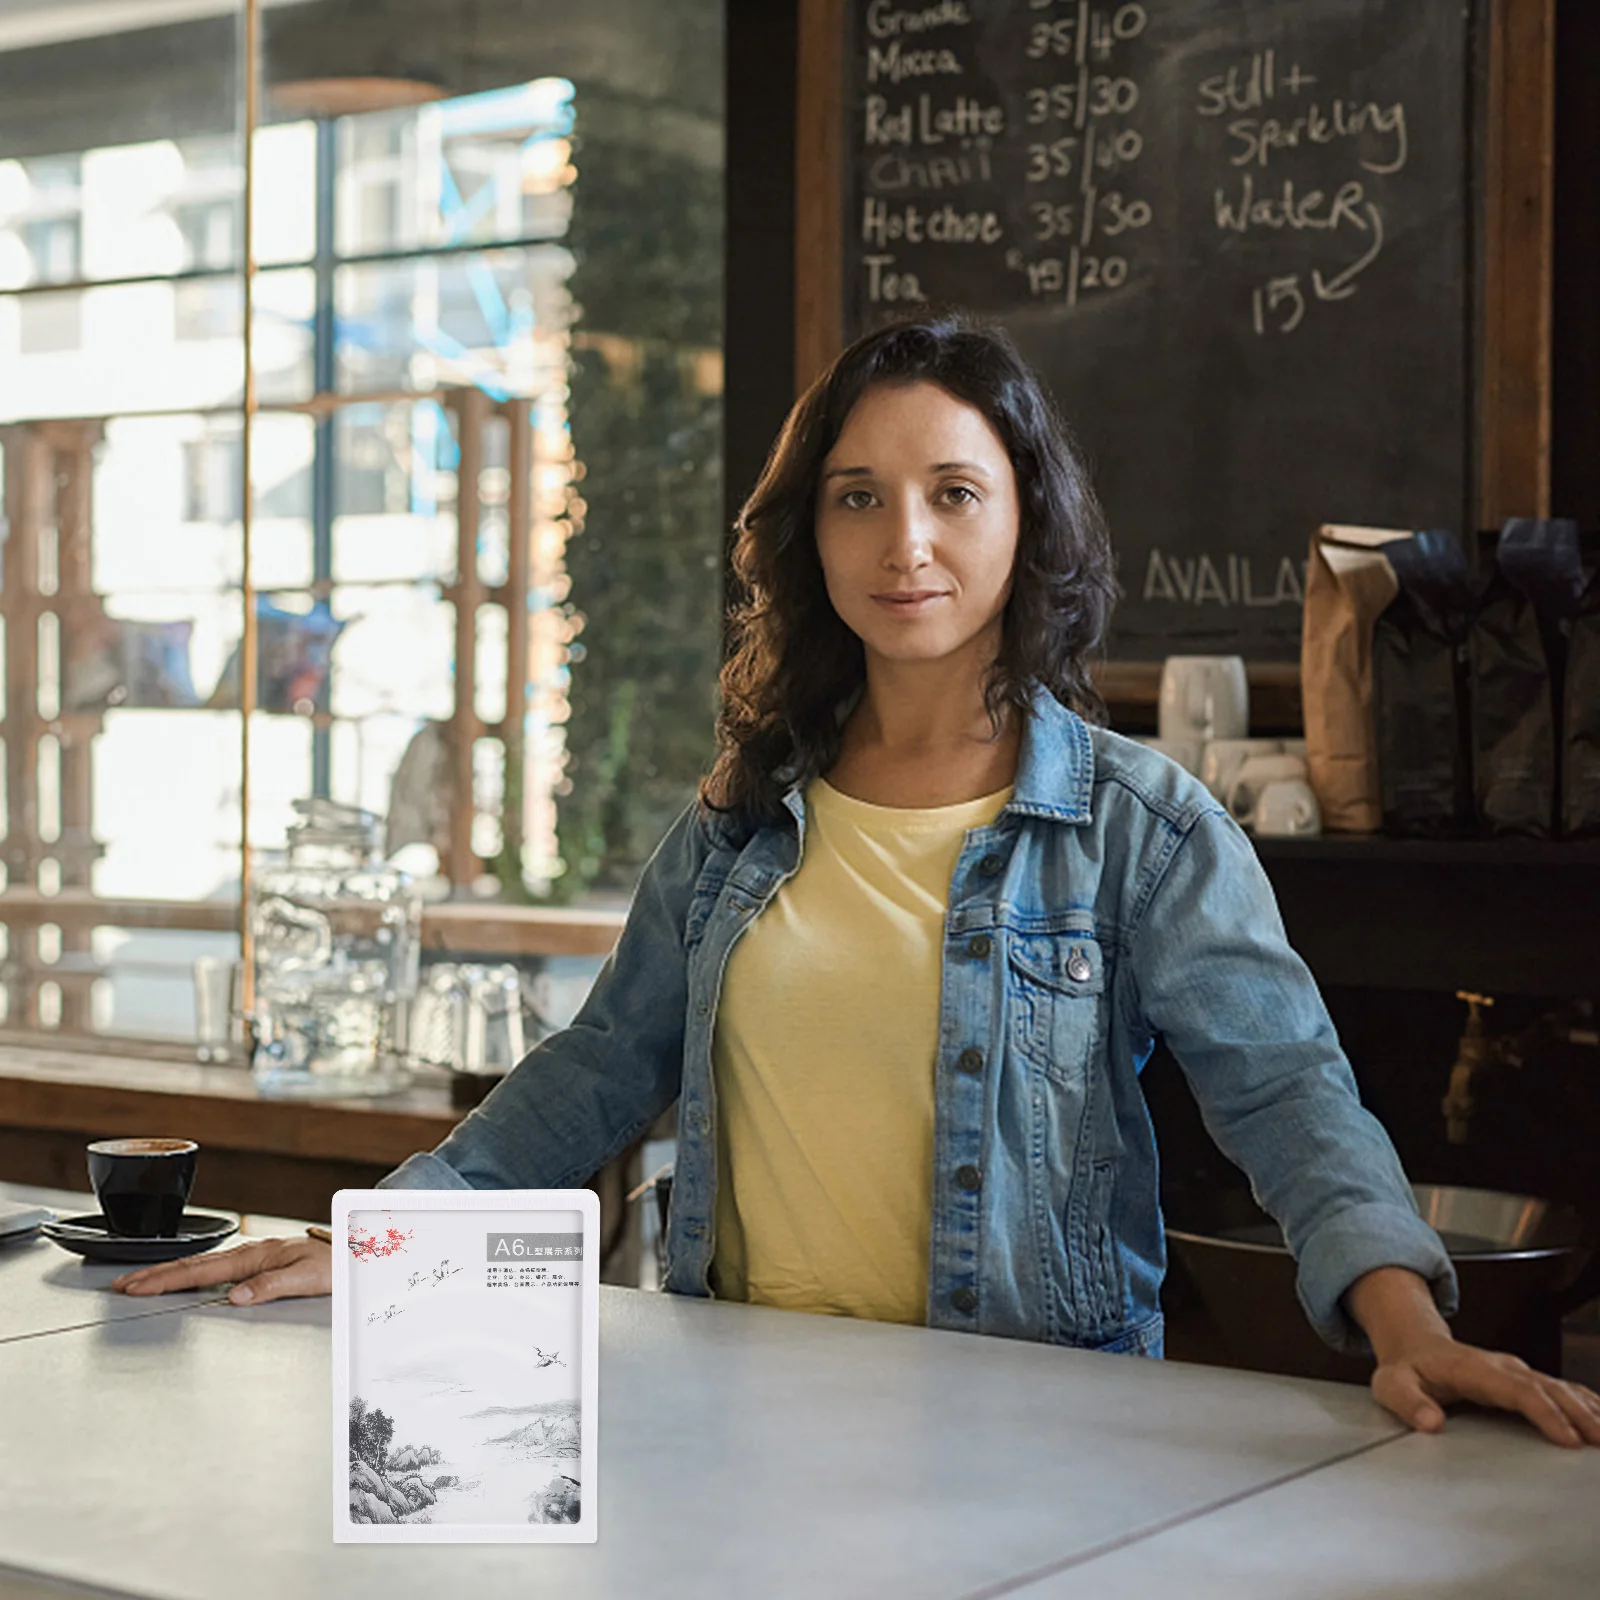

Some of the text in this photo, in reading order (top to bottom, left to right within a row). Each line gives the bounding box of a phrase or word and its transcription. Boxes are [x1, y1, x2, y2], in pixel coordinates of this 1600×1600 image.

[919, 92, 1005, 145] Latte
[862, 196, 924, 249] Hot
[861, 254, 928, 302] Tea
[1251, 274, 1306, 335] 15
[1143, 548, 1308, 607] AVAILA
